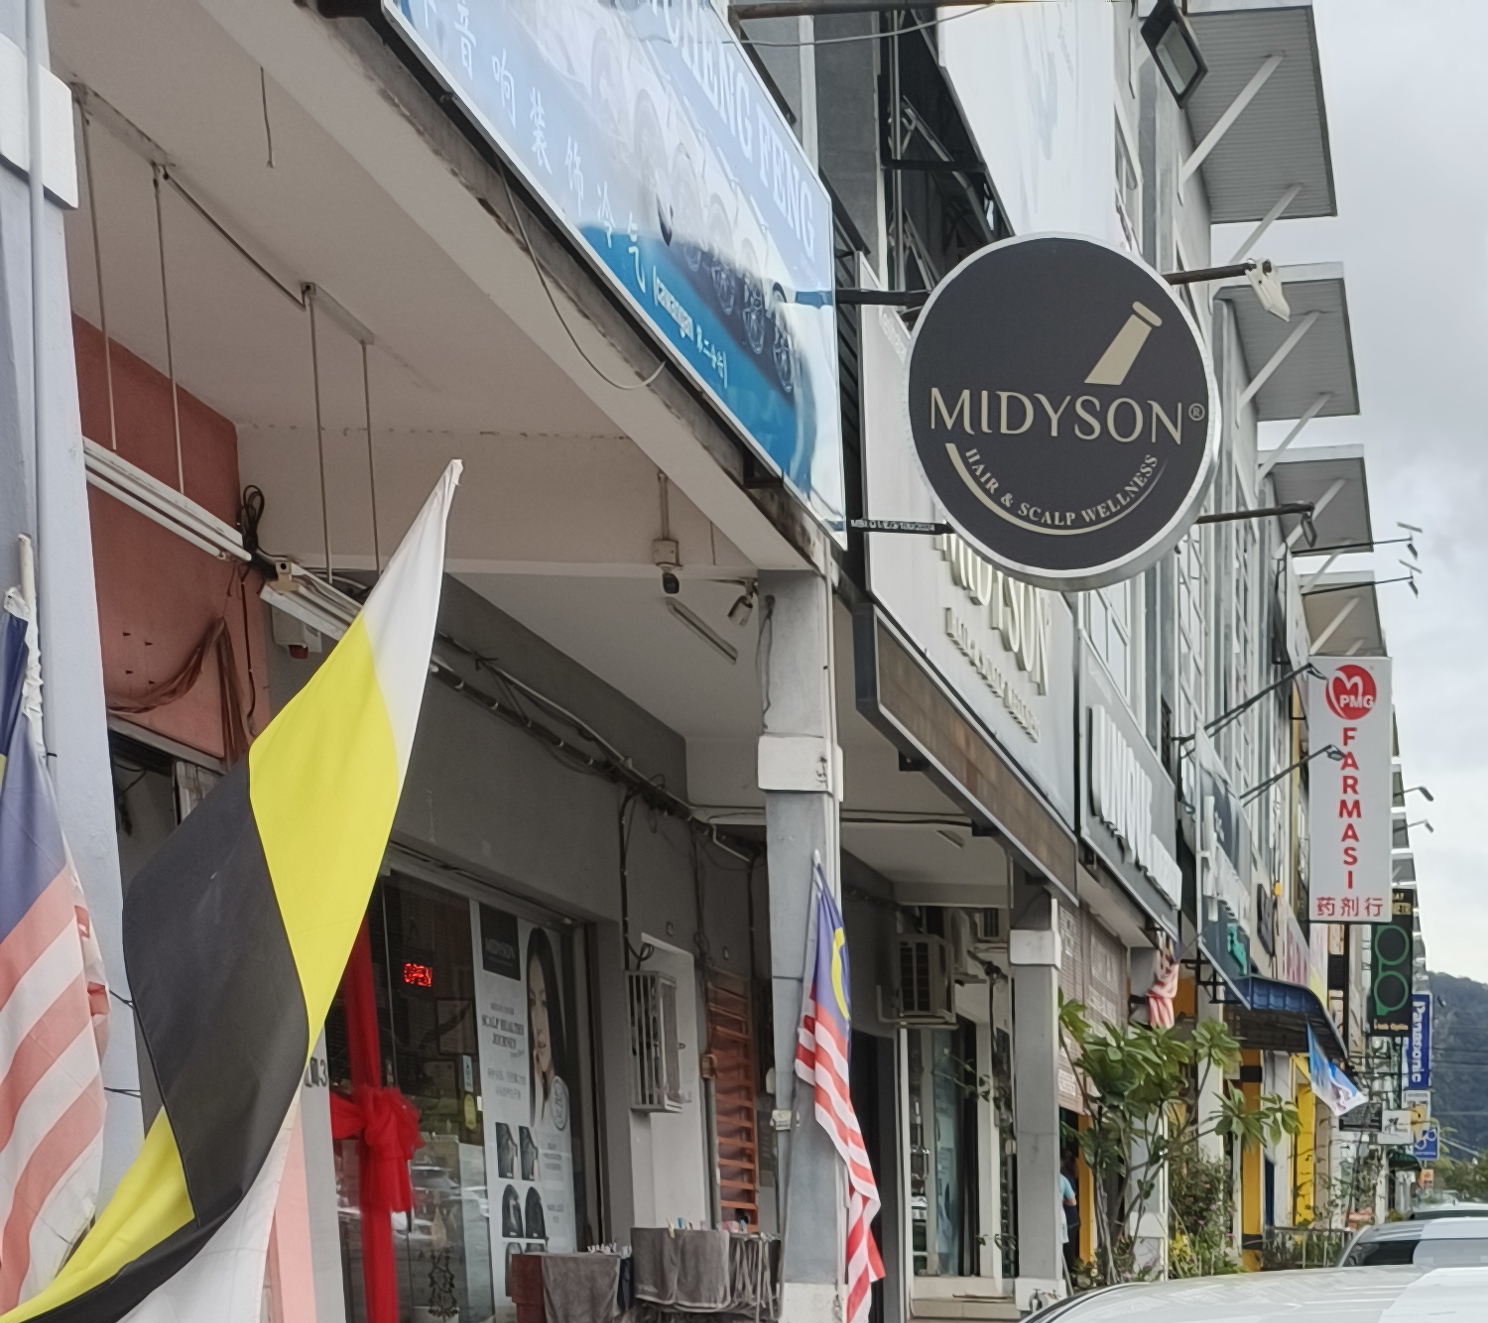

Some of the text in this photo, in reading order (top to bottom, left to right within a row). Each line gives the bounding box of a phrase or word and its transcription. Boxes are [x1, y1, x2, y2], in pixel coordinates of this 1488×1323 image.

[756, 102, 815, 262] FENG
[965, 448, 1158, 526] HAIR & SCALP WELLNESS
[1339, 694, 1375, 709] PMG
[1338, 727, 1362, 889] FARMASI
[1316, 896, 1383, 917] 药剂行
[1412, 1001, 1426, 1083] Panasonic
